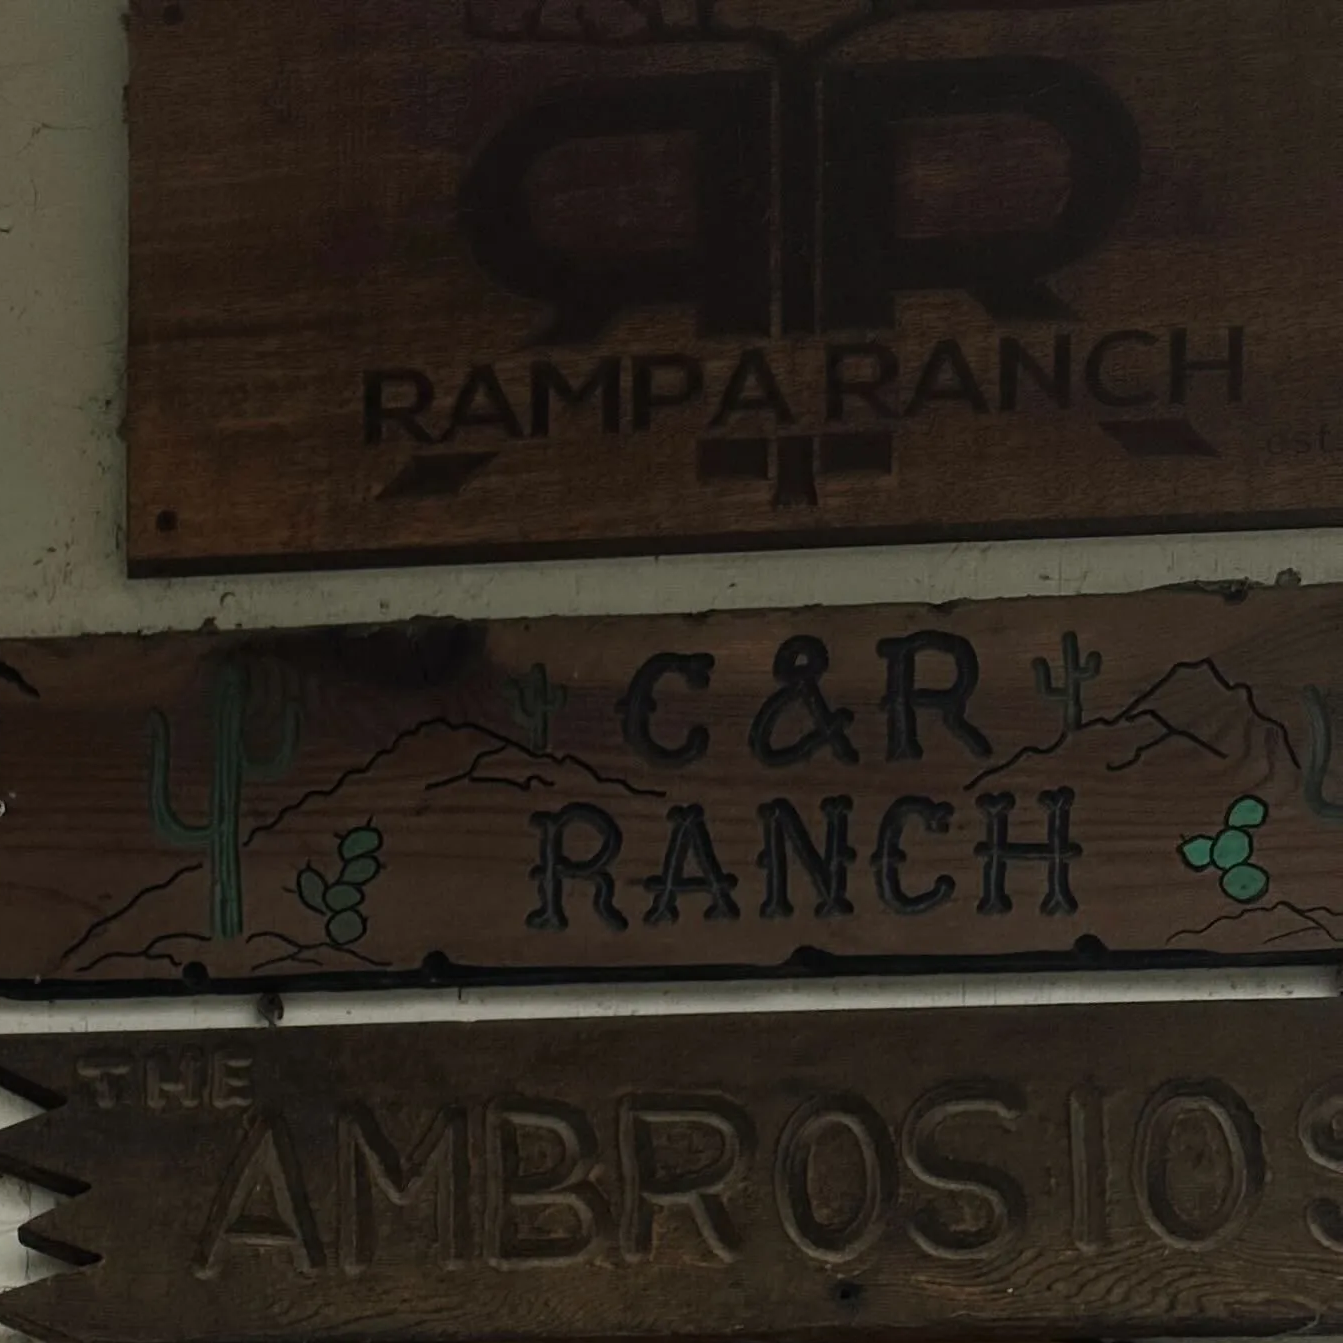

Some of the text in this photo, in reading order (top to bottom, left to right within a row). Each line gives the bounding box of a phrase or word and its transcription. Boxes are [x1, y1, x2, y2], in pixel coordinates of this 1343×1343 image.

[362, 325, 1244, 447] RAMPA RANCH
[525, 786, 1082, 932] RANCH
[75, 1043, 255, 1110] THE
